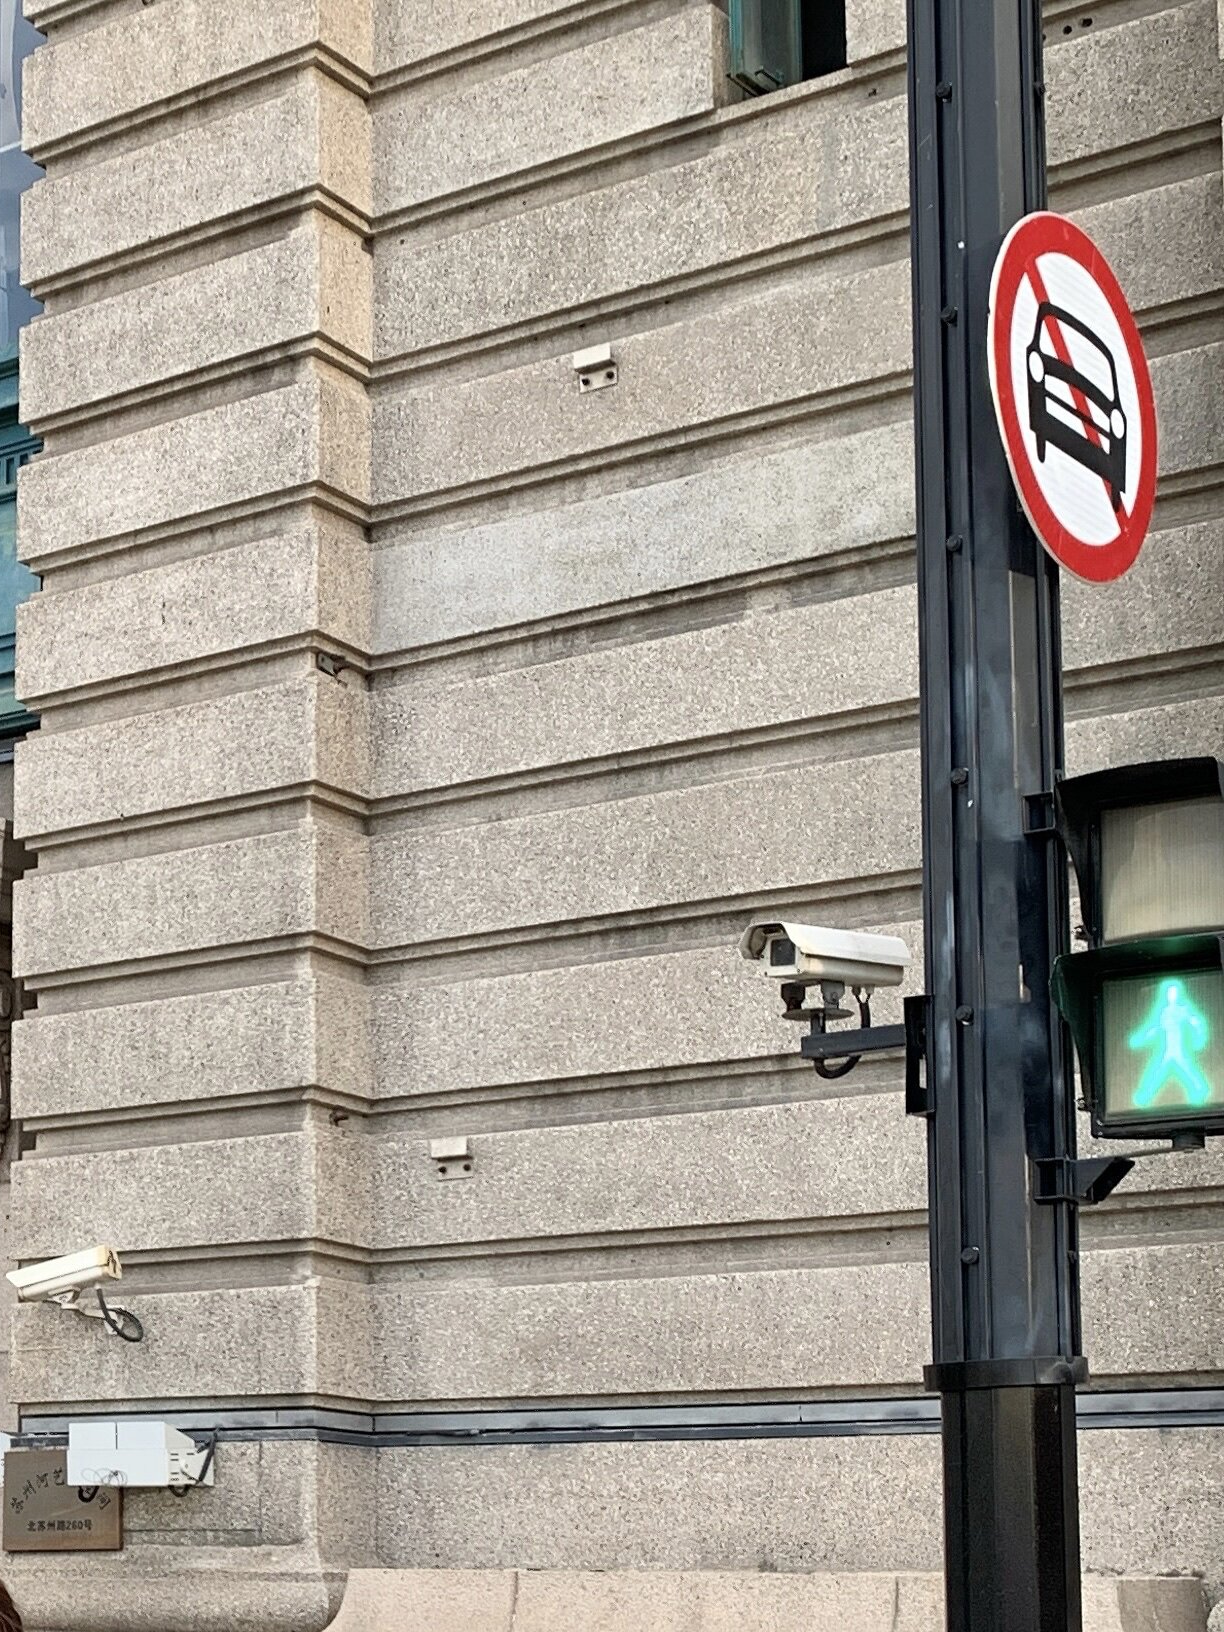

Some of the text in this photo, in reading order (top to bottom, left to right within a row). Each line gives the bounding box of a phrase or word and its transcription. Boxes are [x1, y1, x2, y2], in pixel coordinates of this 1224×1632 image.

[27, 1519, 92, 1532] 北苏州路260号
